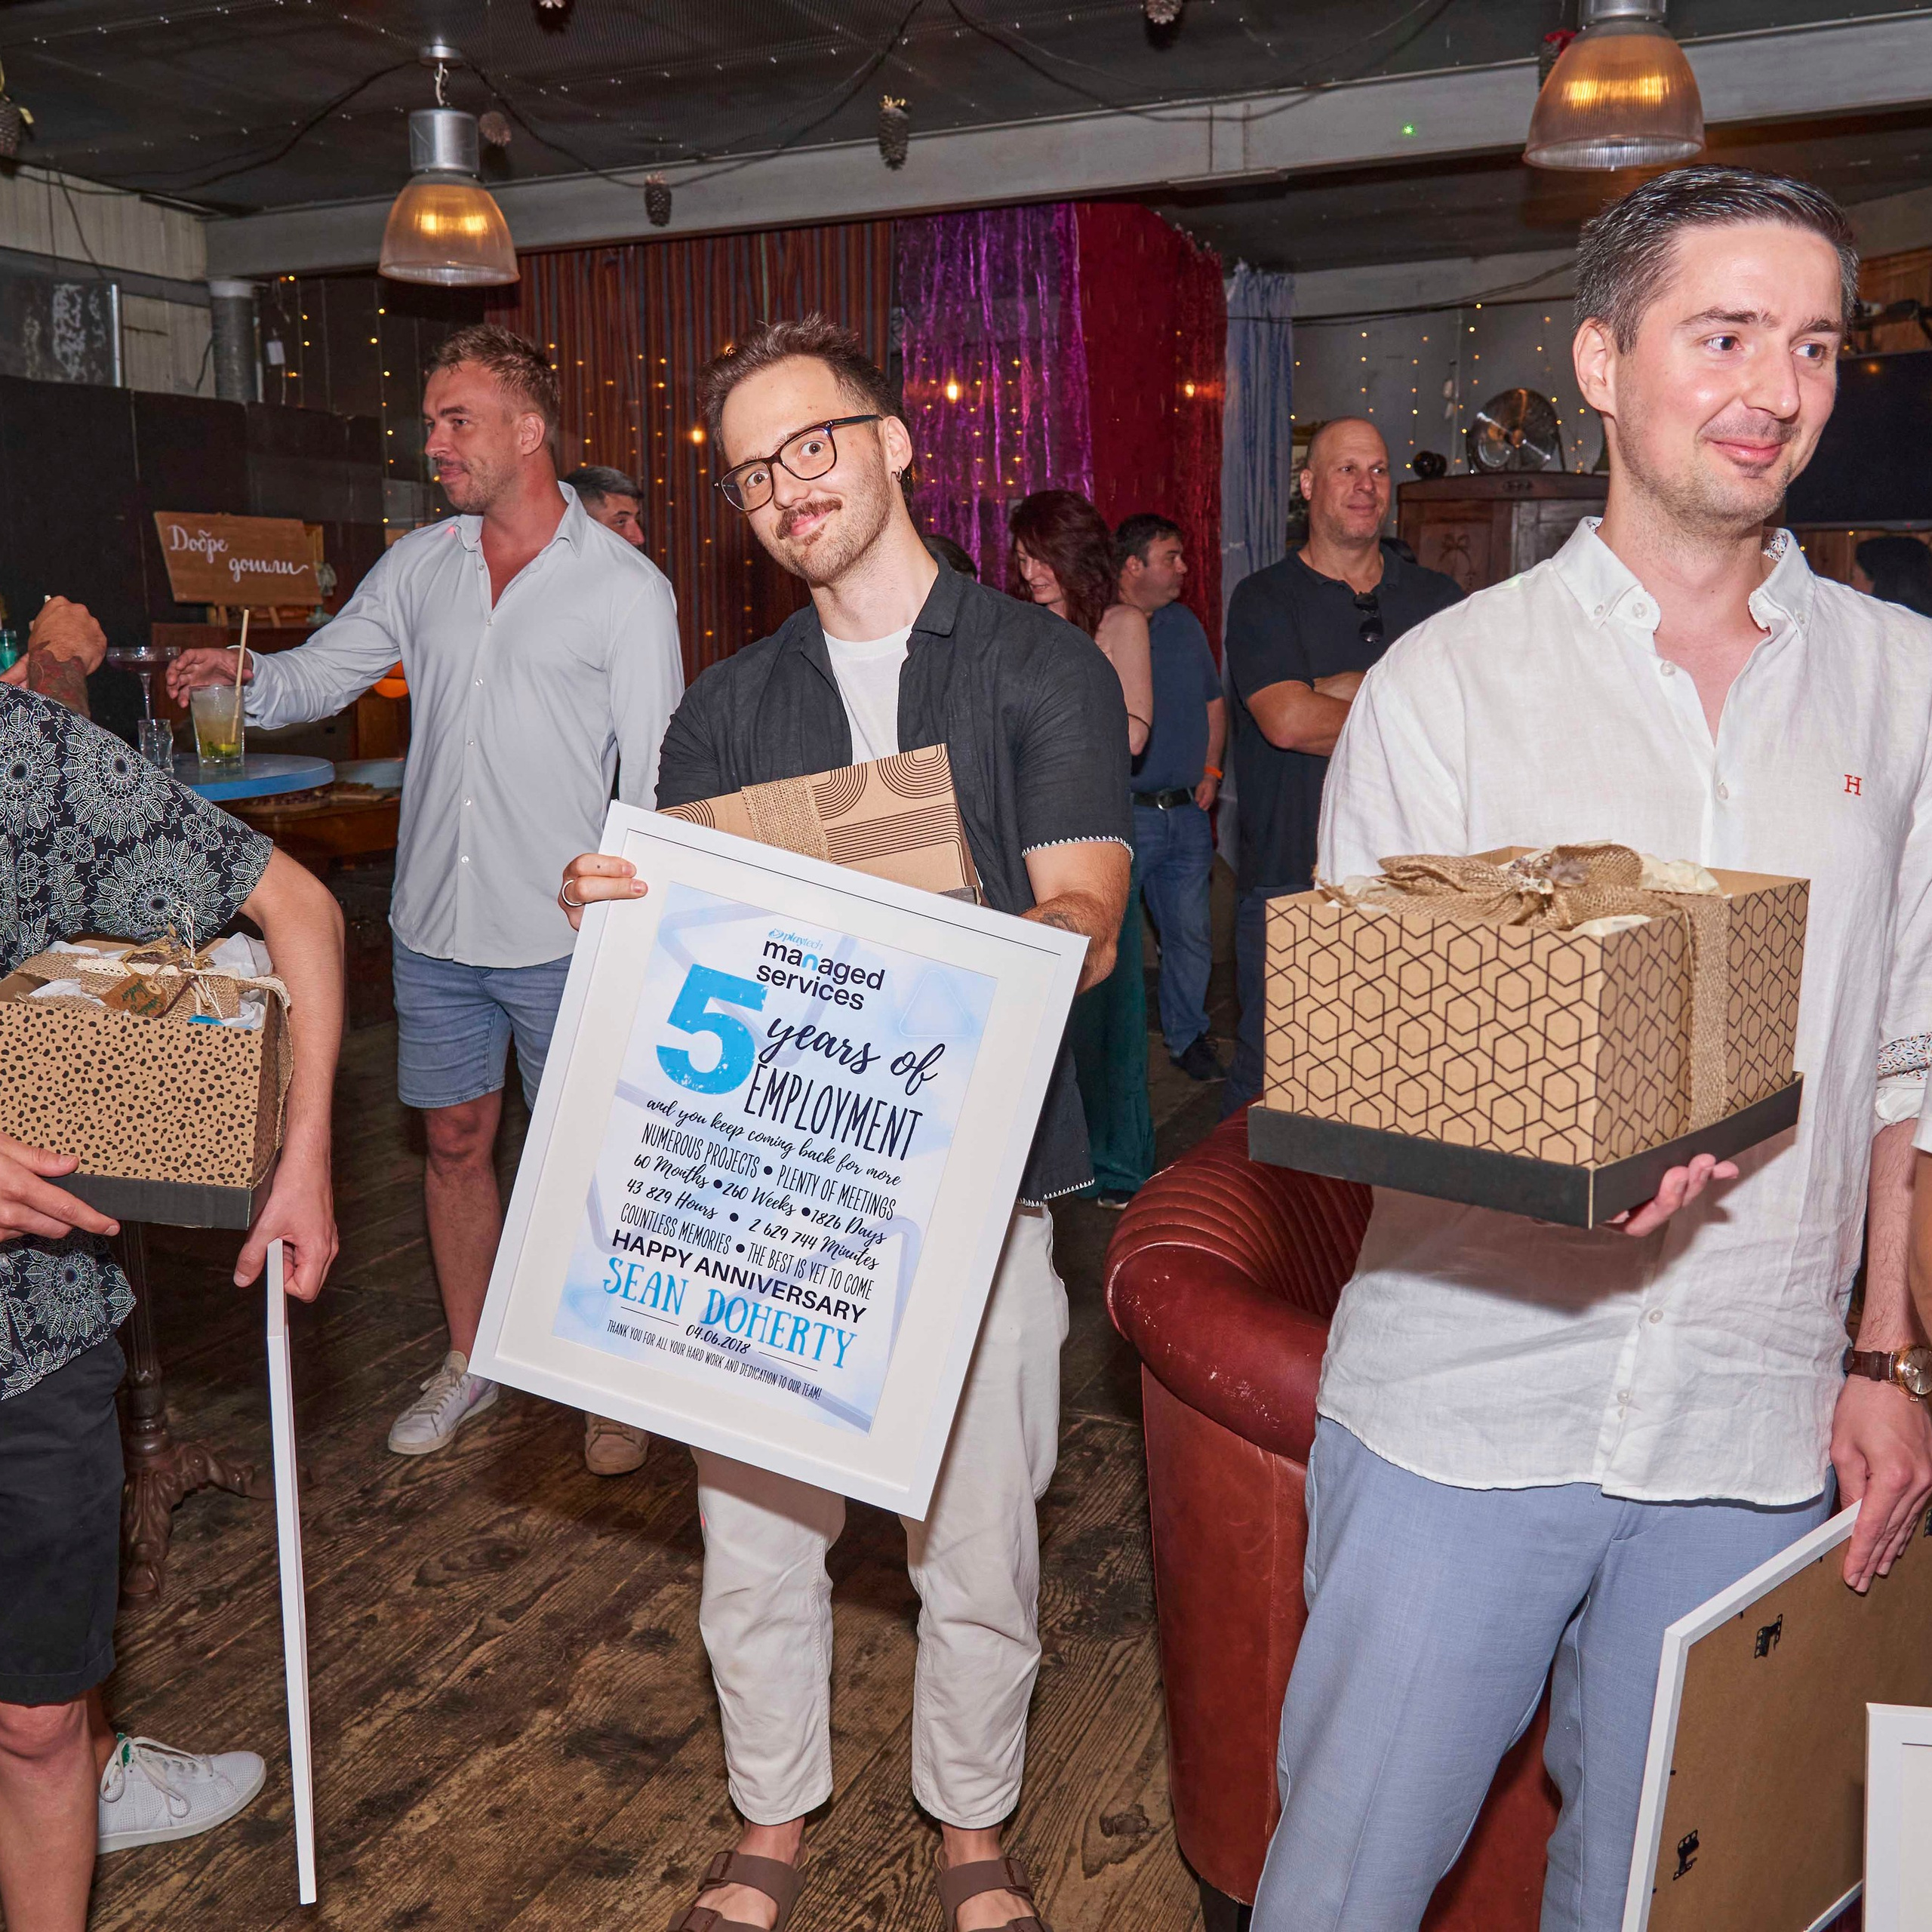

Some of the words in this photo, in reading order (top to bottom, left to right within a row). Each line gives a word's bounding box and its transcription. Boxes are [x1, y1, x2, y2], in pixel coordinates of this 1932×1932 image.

[167, 524, 228, 565] Добре
[229, 557, 309, 583] дошли
[1844, 774, 1862, 796] H
[763, 940, 885, 991] managed
[782, 932, 823, 950] playtech
[657, 963, 769, 1095] 5
[758, 1017, 881, 1075] years
[890, 1043, 946, 1096] of
[756, 964, 864, 1011] services
[647, 1100, 678, 1118] and
[678, 1109, 707, 1127] you
[711, 1113, 745, 1142] keep
[748, 1129, 795, 1159] coming
[798, 1137, 835, 1164] back
[835, 1153, 863, 1175] for
[866, 1167, 901, 1186] more
[744, 1063, 923, 1161] EMPLOYMENT
[634, 1154, 651, 1170] 60
[653, 1155, 709, 1189] Months
[722, 1183, 749, 1201] 260
[752, 1188, 797, 1217] Weeks
[812, 1209, 842, 1231] 1826
[844, 1217, 887, 1246] Days
[641, 1122, 703, 1160] NUMEROUS
[704, 1142, 760, 1178] PROJECTS
[777, 1164, 820, 1198] PLENTY
[820, 1179, 835, 1201] OF
[836, 1183, 897, 1221] MEETINGS
[620, 1202, 678, 1238] COUNTLESS
[678, 1221, 731, 1255] MEMORIES
[747, 1242, 766, 1266] THE
[768, 1249, 794, 1275] BEST
[795, 1259, 806, 1278] IS
[808, 1262, 828, 1286] YET
[828, 1269, 841, 1290] TO
[844, 1273, 874, 1300] COME
[626, 1179, 642, 1194] 43
[646, 1186, 672, 1203] 829
[675, 1193, 718, 1220] Hours
[748, 1219, 758, 1232] 2
[763, 1223, 789, 1241] 629
[795, 1232, 818, 1250] 744
[819, 1235, 879, 1271] Minutes
[603, 1257, 689, 1315] SEAN
[700, 1288, 857, 1369] DOHERTY
[612, 1229, 694, 1268] HAPPY
[694, 1257, 867, 1324] ANNIVERSARY
[607, 1319, 629, 1337] THANK
[629, 1326, 644, 1341] YOU
[644, 1331, 656, 1346] FOR
[656, 1334, 667, 1350] ALL
[668, 1340, 688, 1356] YOUR
[687, 1345, 704, 1361] HARD
[704, 1350, 724, 1369] WORK
[725, 1358, 739, 1374] AND
[740, 1362, 779, 1386] DEDICATION
[780, 1375, 787, 1389] TO
[787, 1379, 801, 1392] OUR
[801, 1383, 823, 1401] TEAM!
[686, 1324, 751, 1355] 04.06.2018
